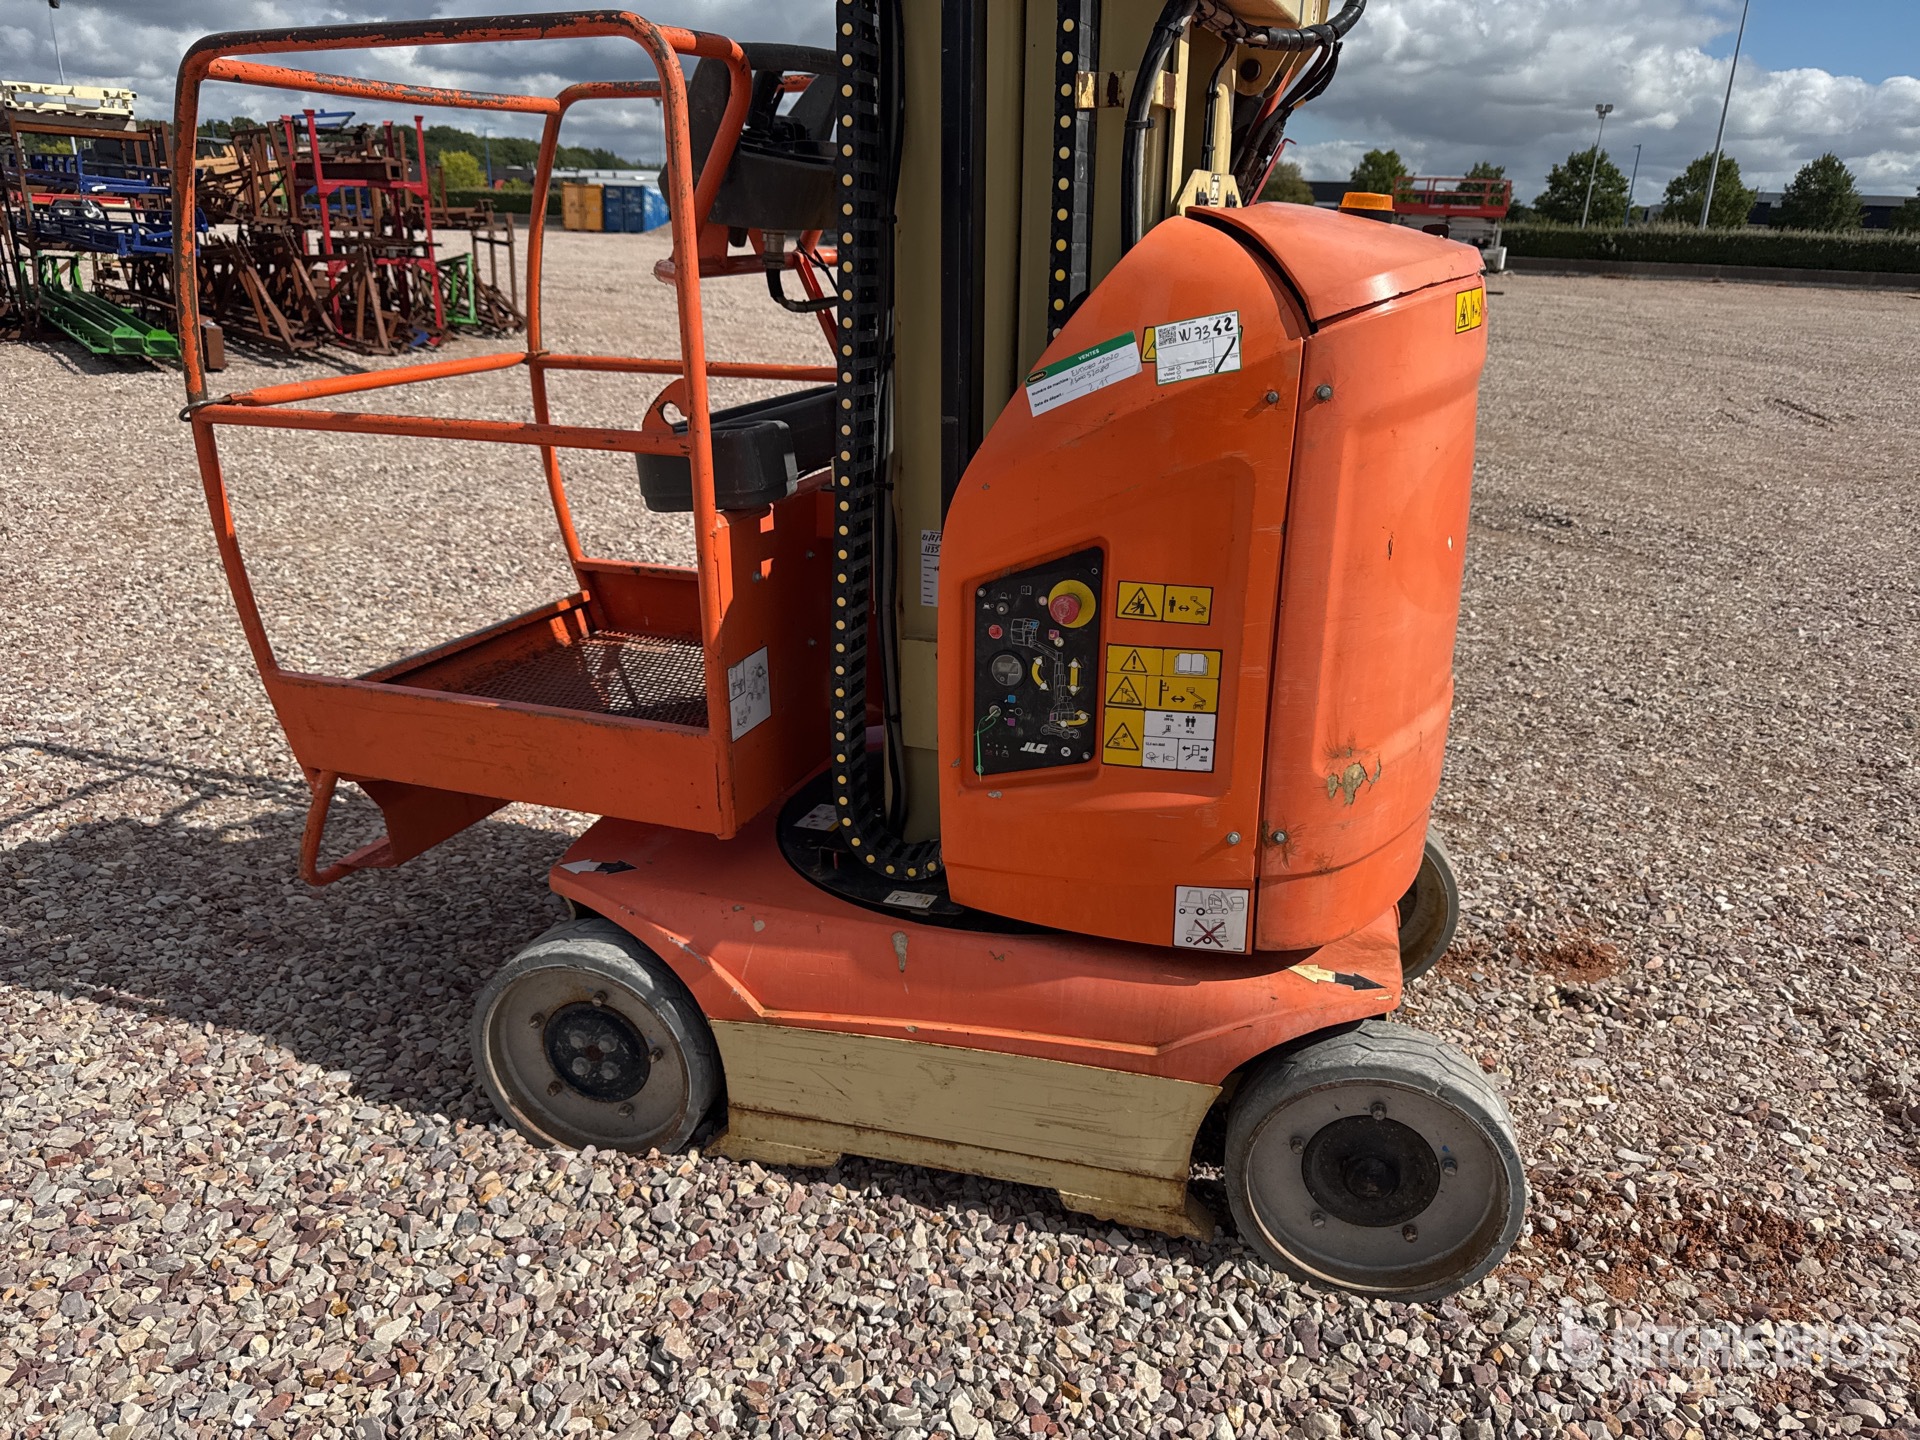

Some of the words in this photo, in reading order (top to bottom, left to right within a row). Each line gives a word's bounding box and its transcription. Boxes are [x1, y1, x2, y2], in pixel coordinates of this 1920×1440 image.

[1078, 348, 1100, 361] VENTES
[1053, 378, 1069, 387] machine
[1020, 742, 1048, 754] JLG
